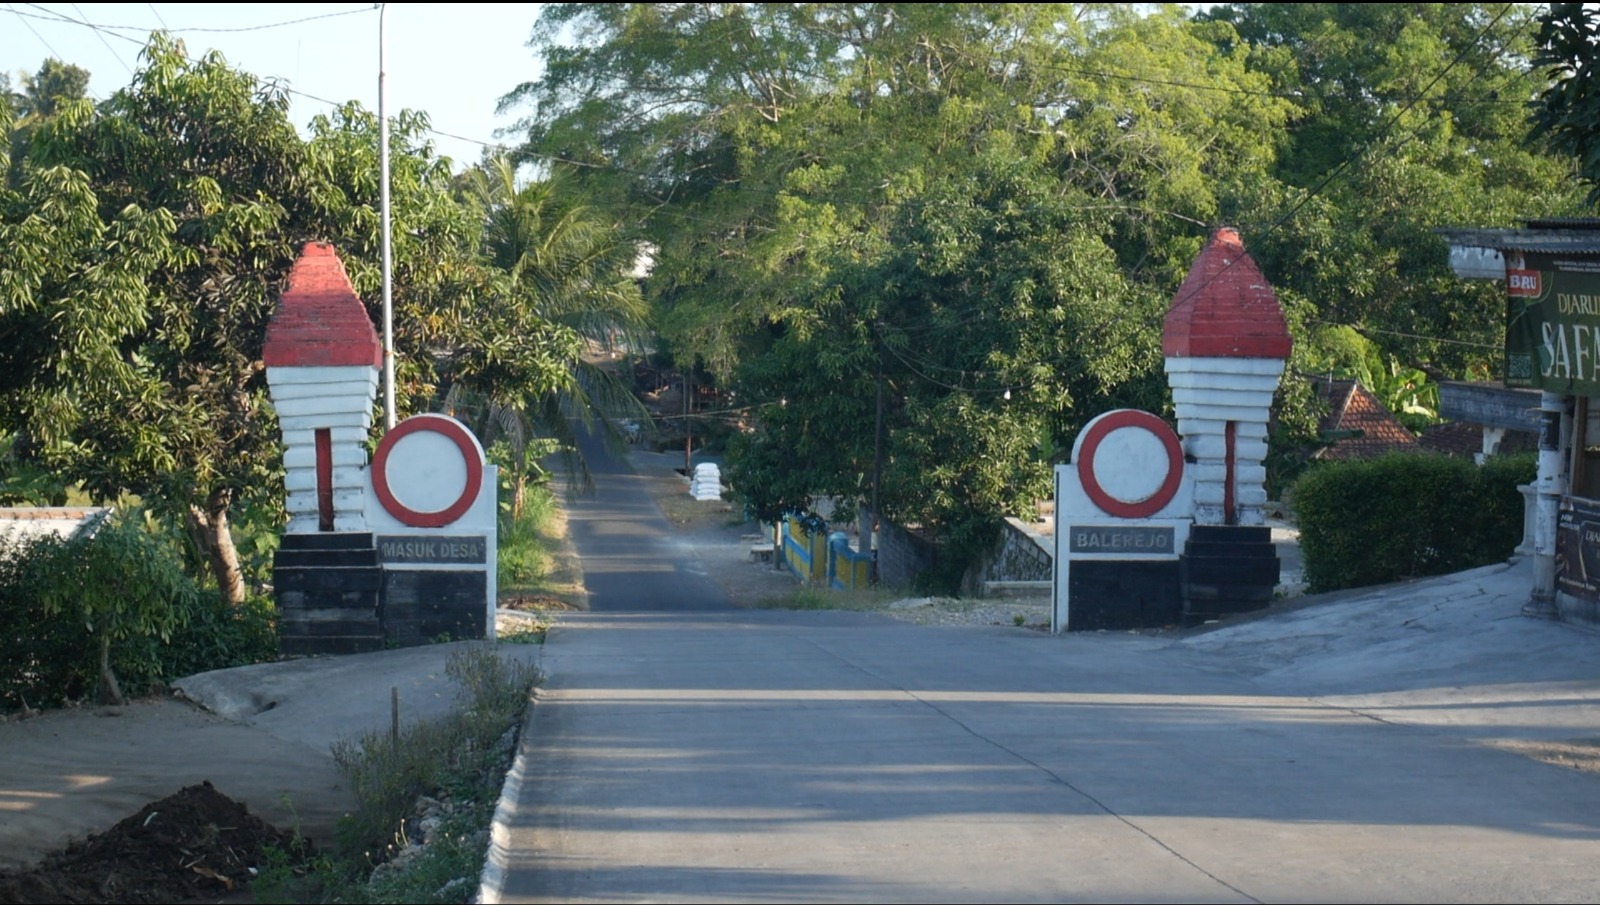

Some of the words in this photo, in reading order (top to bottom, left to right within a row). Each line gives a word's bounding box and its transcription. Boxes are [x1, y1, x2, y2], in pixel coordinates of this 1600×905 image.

[1557, 293, 1600, 315] DJARU
[1076, 533, 1167, 548] BALEREJO
[382, 542, 435, 558] MASUK
[440, 543, 479, 558] DESA
